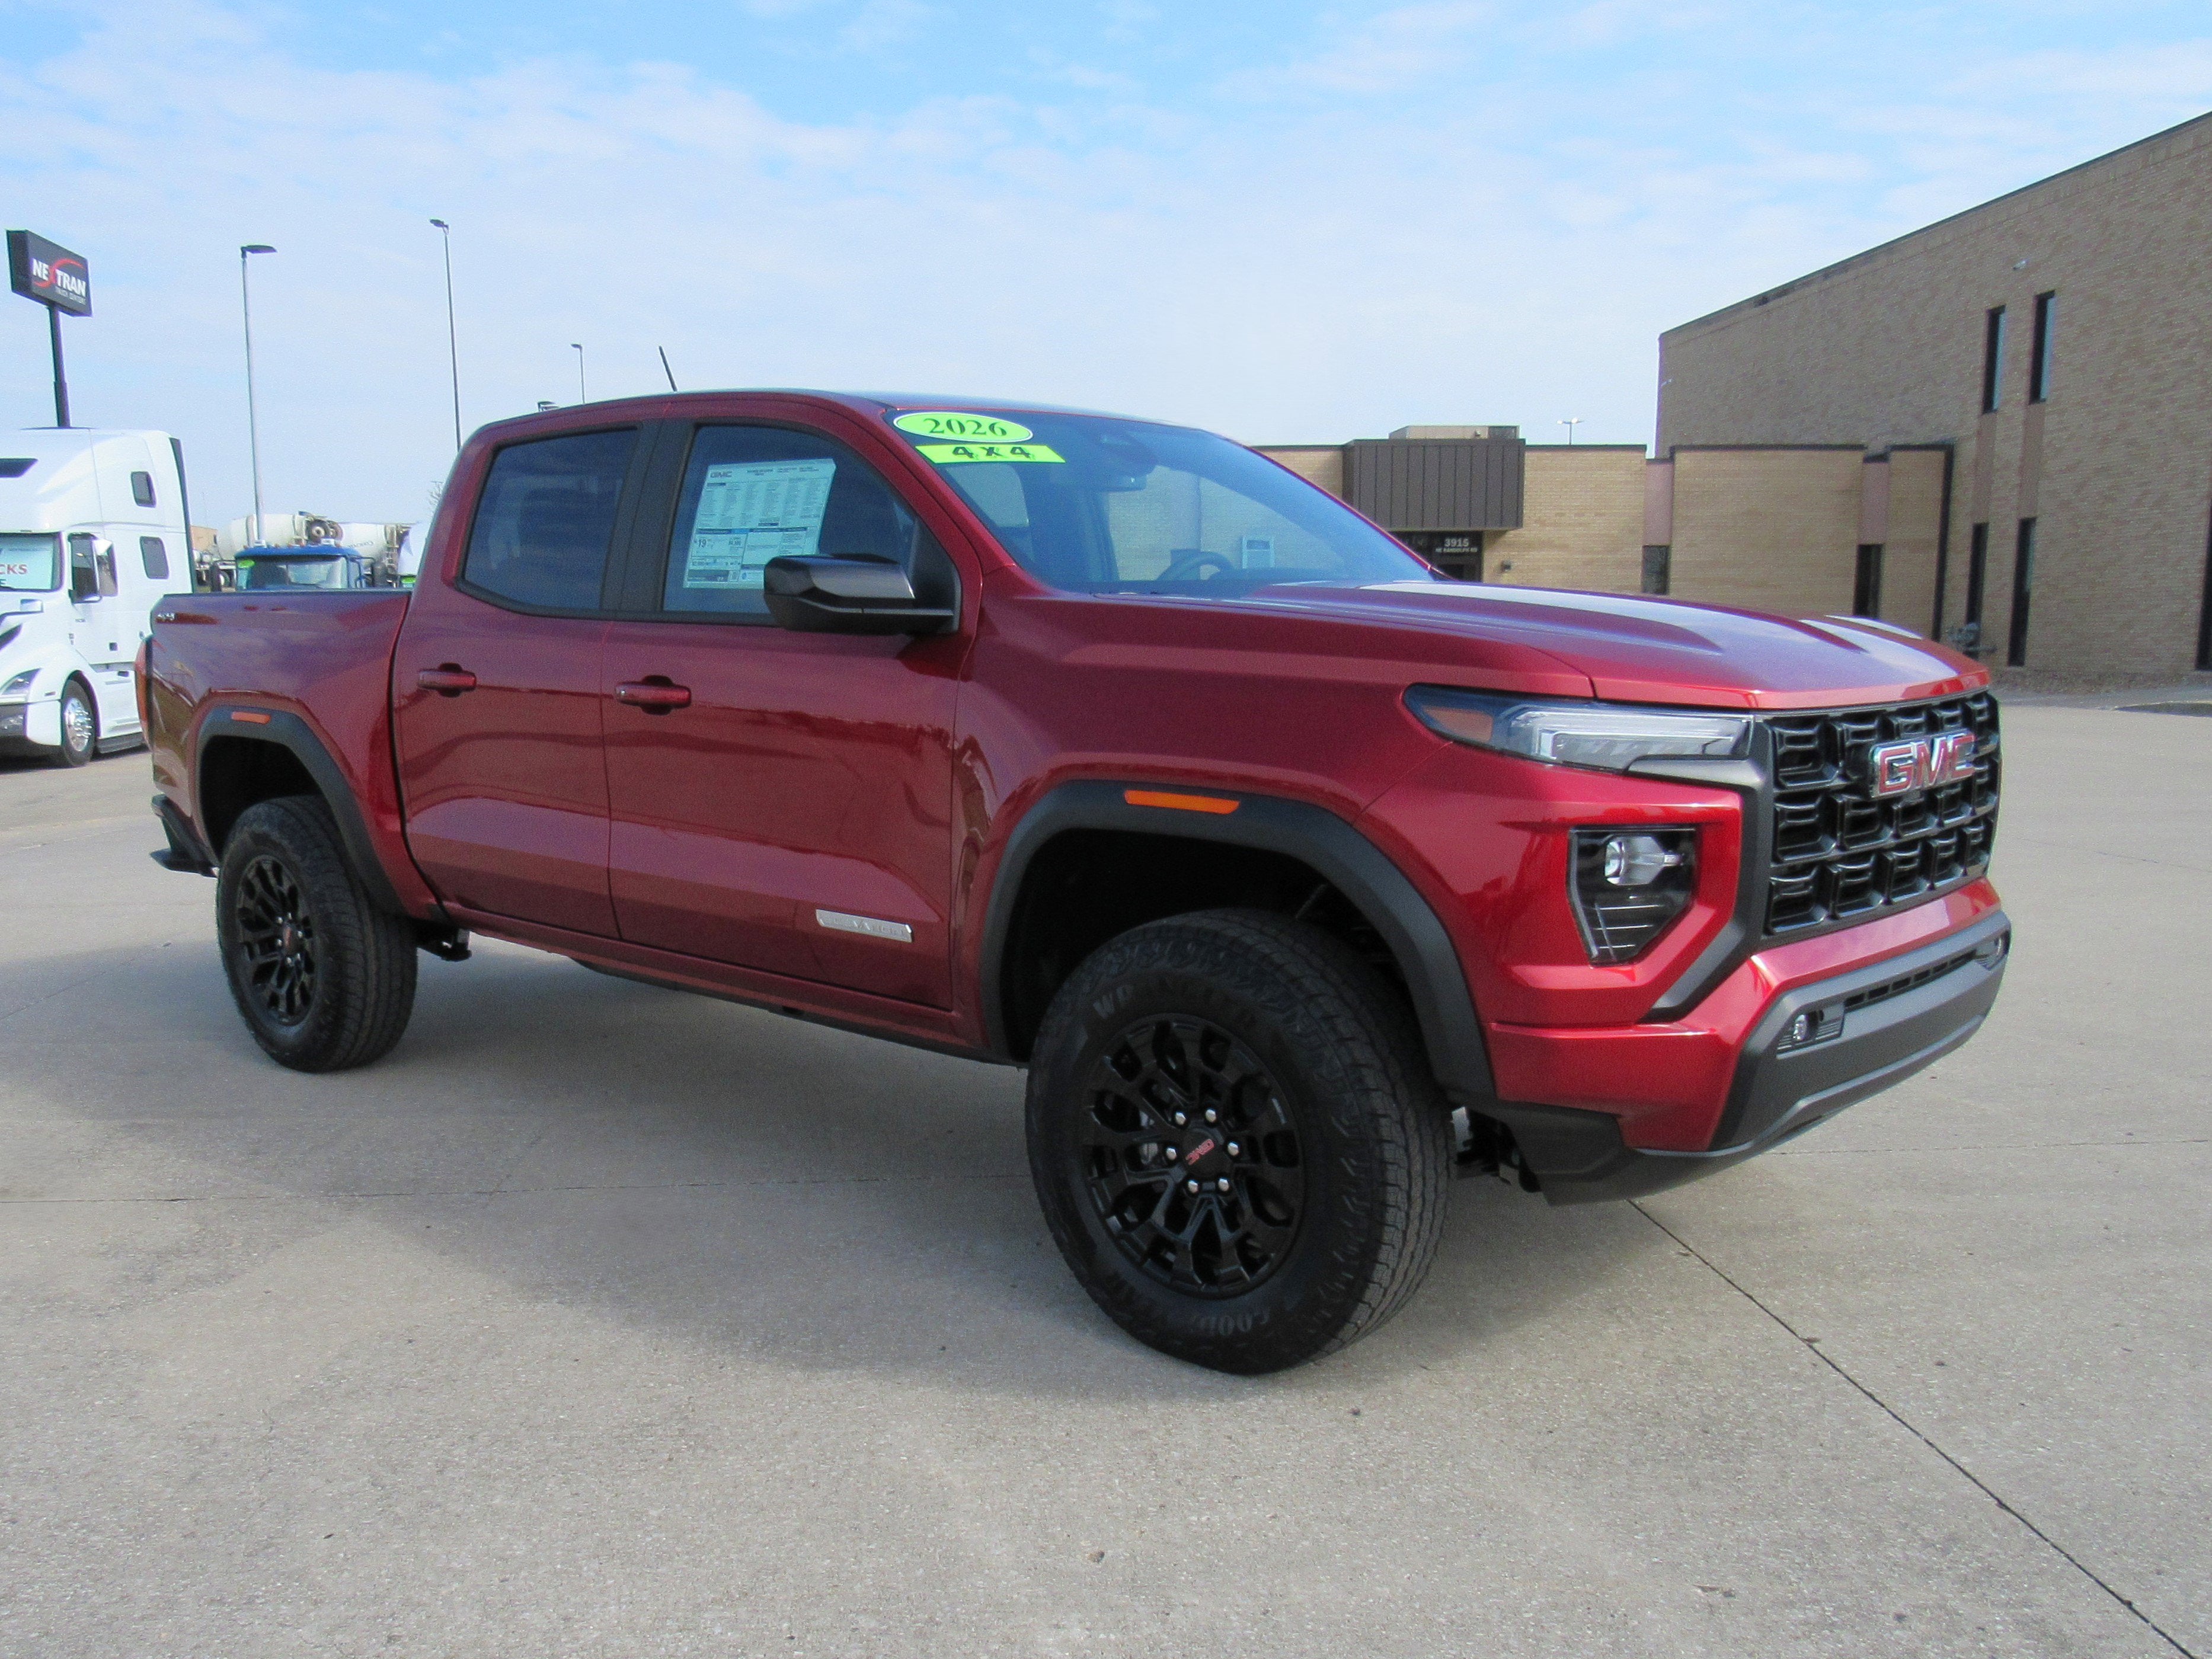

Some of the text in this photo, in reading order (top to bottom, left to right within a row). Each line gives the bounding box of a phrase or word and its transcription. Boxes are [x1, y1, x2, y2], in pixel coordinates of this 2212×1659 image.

[923, 417, 1008, 437] 2026
[1871, 731, 1977, 798] GMC
[1186, 1139, 1214, 1166] GMC
